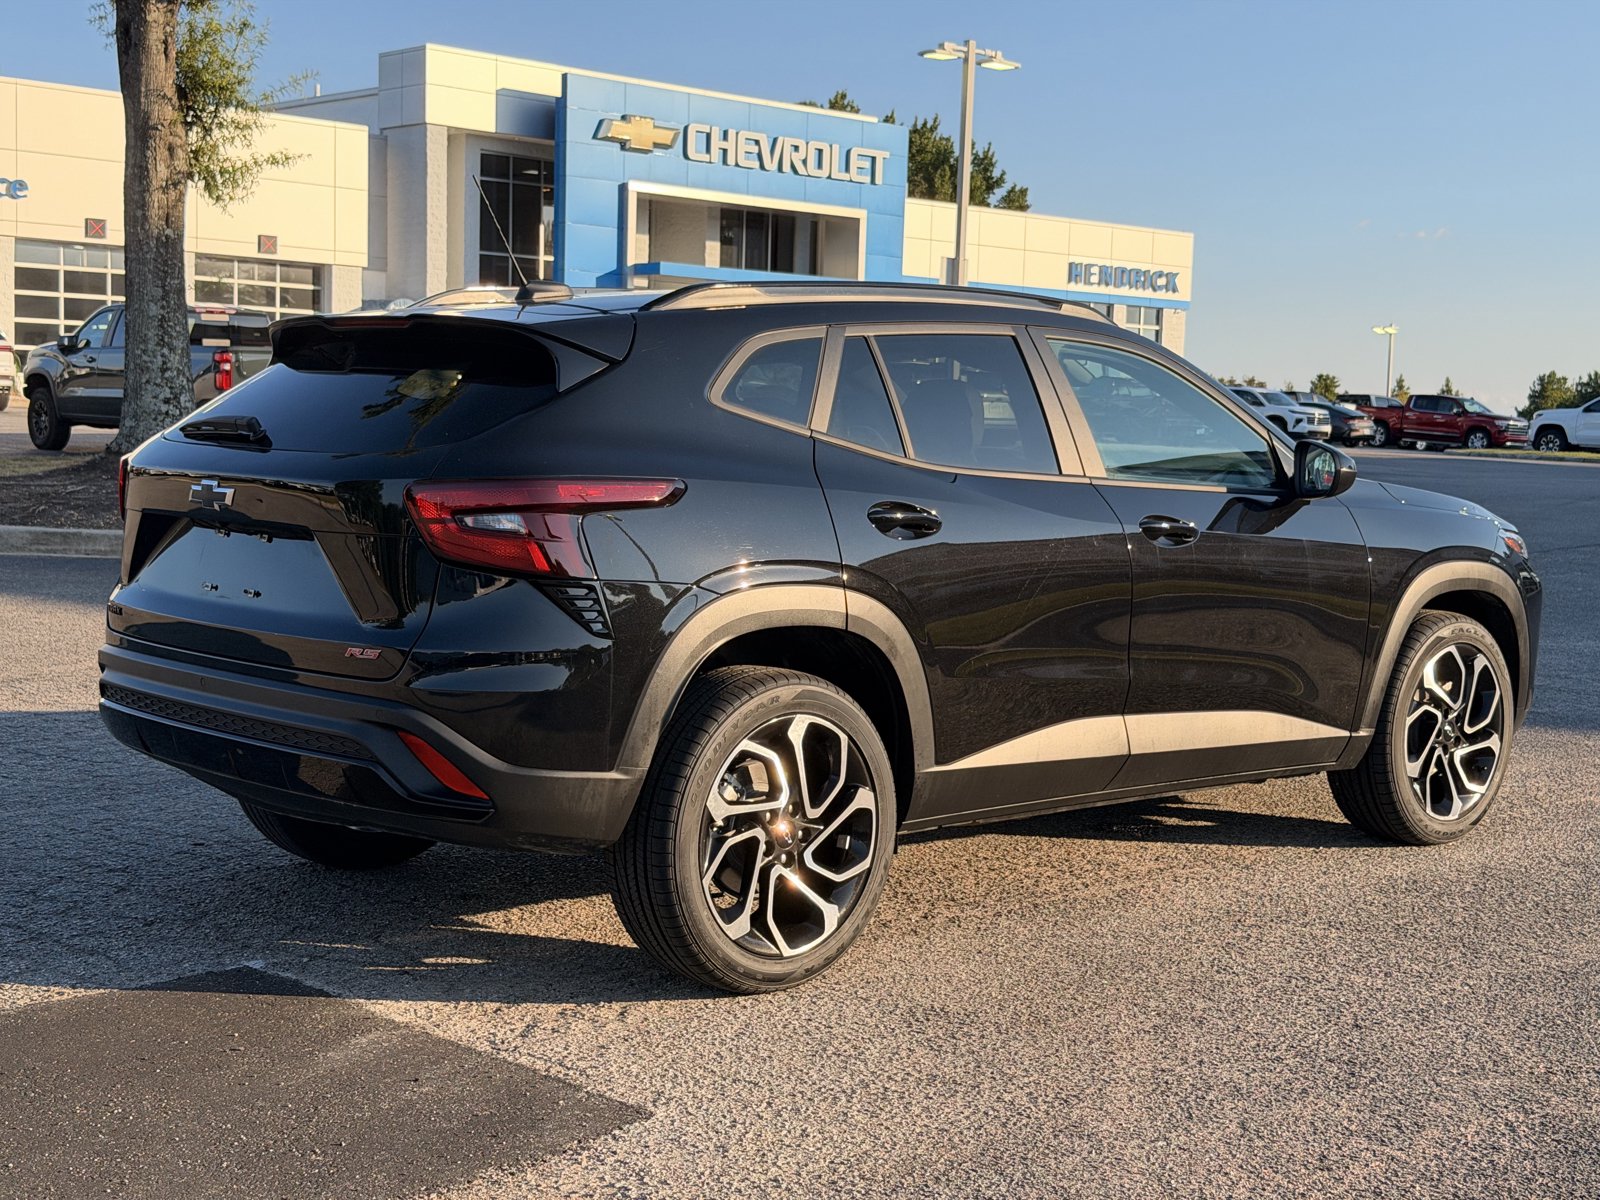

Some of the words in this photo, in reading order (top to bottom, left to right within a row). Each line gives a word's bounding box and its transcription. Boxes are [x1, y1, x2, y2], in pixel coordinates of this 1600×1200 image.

[684, 123, 890, 186] CHEVROLET
[1067, 261, 1180, 294] HENDRICK
[344, 647, 382, 660] RS
[690, 694, 781, 809] GOODYEAR
